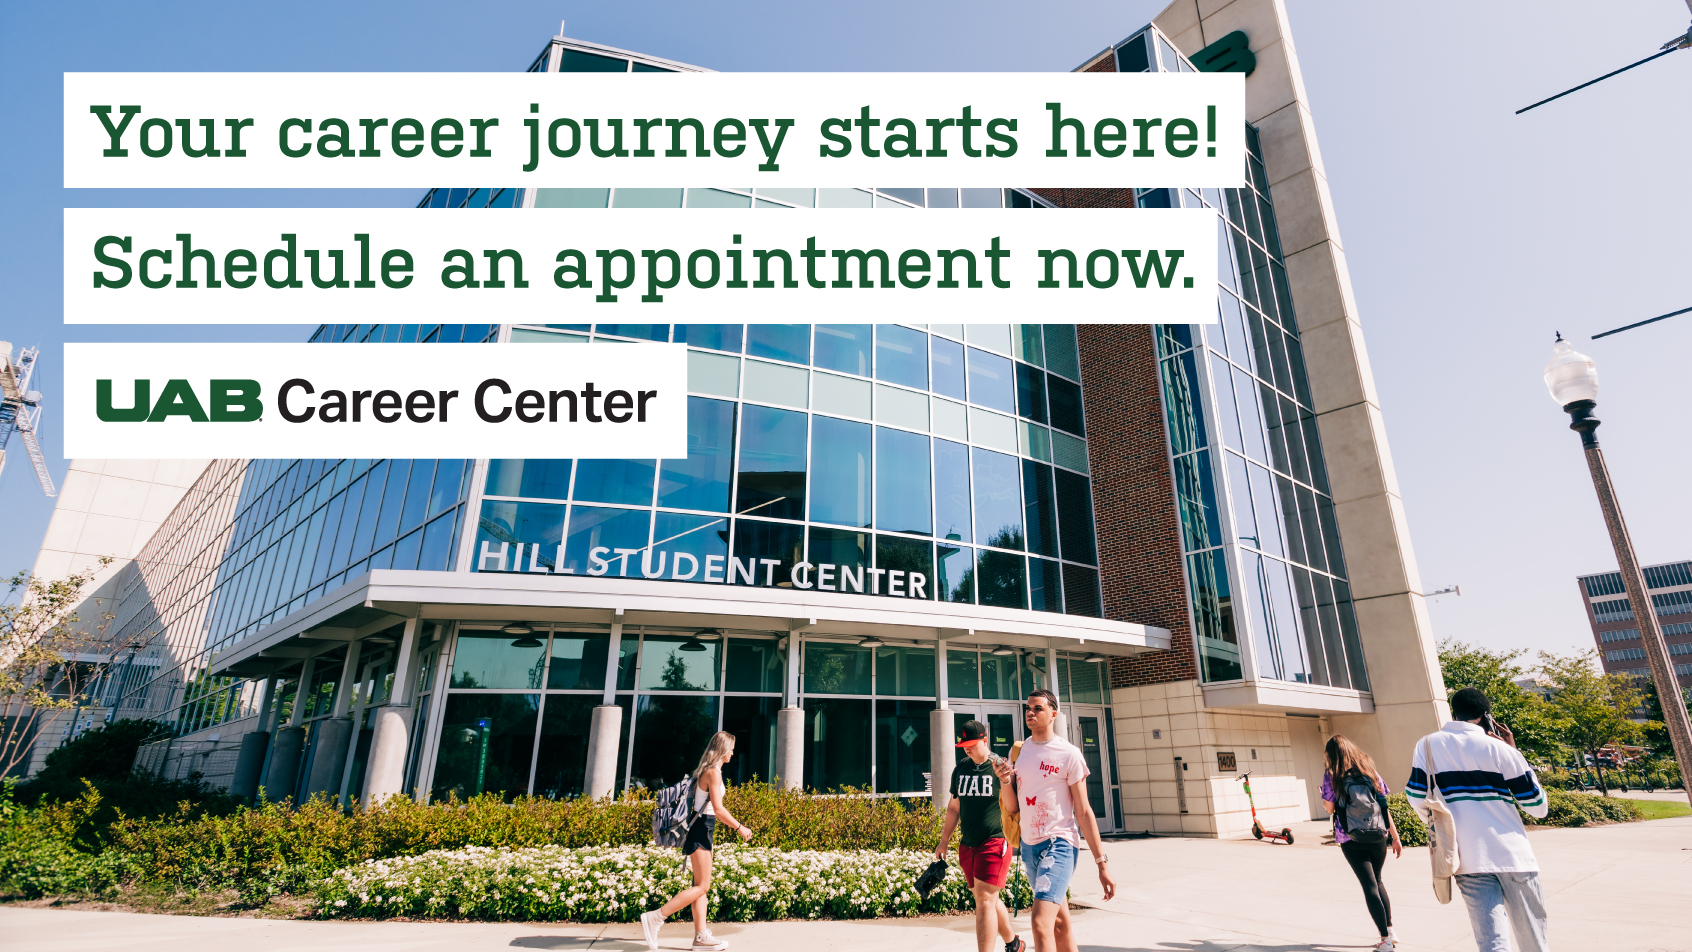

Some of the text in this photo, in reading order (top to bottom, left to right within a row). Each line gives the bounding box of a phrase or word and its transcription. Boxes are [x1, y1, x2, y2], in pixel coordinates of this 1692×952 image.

[478, 540, 927, 598] HILL STUDENT CENTER
[1039, 760, 1059, 775] hope
[1219, 755, 1236, 769] 1400
[957, 775, 993, 797] UAB
